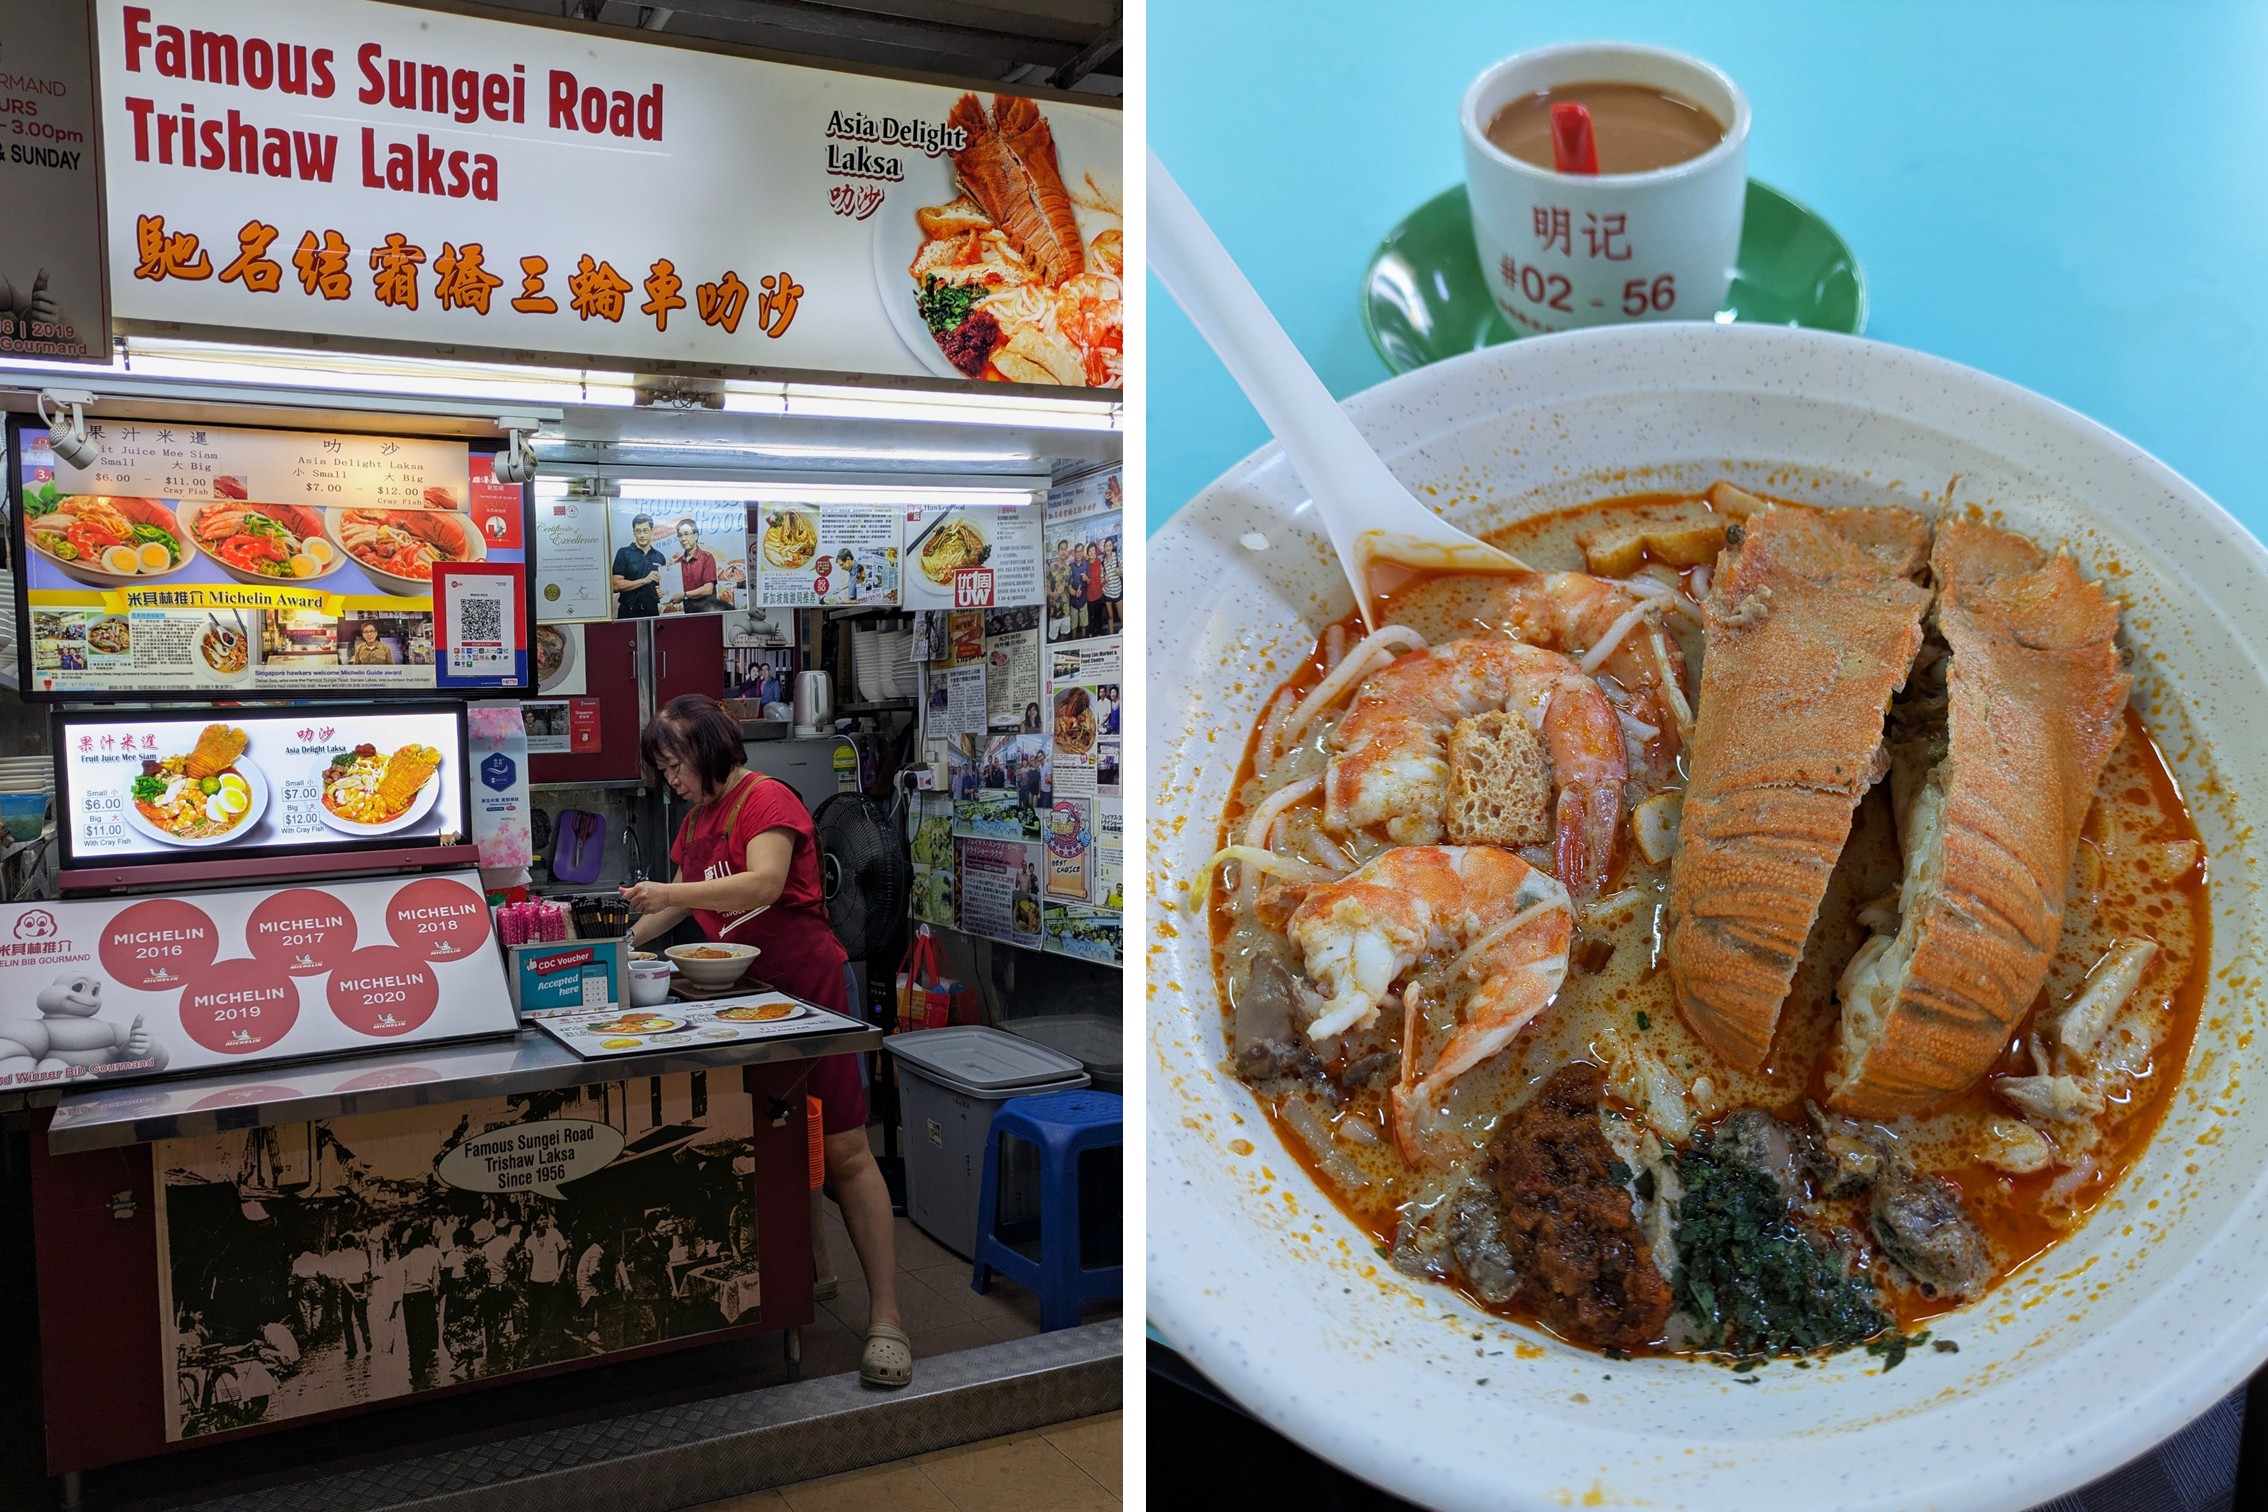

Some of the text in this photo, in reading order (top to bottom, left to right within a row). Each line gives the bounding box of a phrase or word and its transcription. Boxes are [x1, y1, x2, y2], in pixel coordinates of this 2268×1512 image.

[122, 5, 665, 142] Famous Sungei Road
[12, 119, 84, 144] 3.00pm
[826, 110, 968, 158] Asia Delight
[125, 96, 500, 202] Trishaw Laksa
[11, 143, 82, 171] SUNDAY
[826, 144, 904, 182] Laksa
[828, 184, 885, 221] 叻沙
[1532, 205, 1633, 261] 明记
[1499, 253, 1574, 313] #02
[1621, 273, 1676, 317] 56
[32, 321, 76, 338] 2019
[0, 336, 87, 355] Gourmand
[121, 446, 156, 456] Juice
[163, 448, 184, 457] Mee
[190, 450, 218, 459] Siam
[101, 457, 212, 472] Small 大 Big
[298, 456, 424, 471] Asia Delight Laksa
[95, 473, 206, 486] $6.00 $11.00
[292, 467, 424, 484] 小 Small 大 Big
[163, 486, 209, 496] Cray Fish
[306, 482, 419, 496] $7.00 $12.00
[377, 498, 398, 506] Cray
[536, 522, 573, 535] Certificate
[549, 533, 600, 546] Excellence
[209, 591, 272, 605] Michelin
[276, 593, 324, 608] Award
[957, 588, 992, 606] UW
[297, 725, 336, 743] 叻沙
[81, 752, 157, 763] Fruit Juice Mee Siam
[285, 745, 346, 755] Asia Delight Laksa
[285, 778, 314, 787] Small 小
[86, 788, 119, 797] Small 小
[284, 787, 317, 800] $7.00
[85, 798, 121, 811] $6.00
[287, 802, 316, 812] Big 大
[89, 814, 119, 823] Big 大
[285, 813, 318, 825] $12.00
[86, 824, 122, 836] $11.00
[281, 825, 325, 835] With Cray Fish
[84, 837, 132, 847] With Cray Fish
[397, 903, 477, 921] MICHELIN
[259, 915, 343, 933] MICHELIN
[417, 920, 458, 934] 2018
[114, 928, 204, 945] MICHELIN
[282, 932, 324, 946] 2017
[136, 945, 182, 959] 2016
[22, 958, 36, 966] BIB
[39, 954, 91, 964] GOURMAND
[290, 961, 323, 969] MICHELIN
[538, 952, 590, 970] CDC Voucher
[143, 976, 179, 984] MICHELIN
[339, 973, 424, 992] MICHELIN
[538, 973, 579, 991] Accepted
[194, 987, 285, 1007] MICHELIN
[362, 990, 406, 1005] 2020
[559, 985, 579, 996] here
[214, 1006, 261, 1021] 2019
[373, 1020, 406, 1029] MICHELIN
[225, 1038, 261, 1047] MICHELIN
[16, 1070, 63, 1083] Winner
[65, 1066, 87, 1078] Bib
[89, 1057, 155, 1073] Gourmand
[464, 1125, 594, 1158] Famous Sungei Road
[485, 1148, 575, 1173] Trishaw Laksa
[498, 1165, 566, 1189] Since 1956
